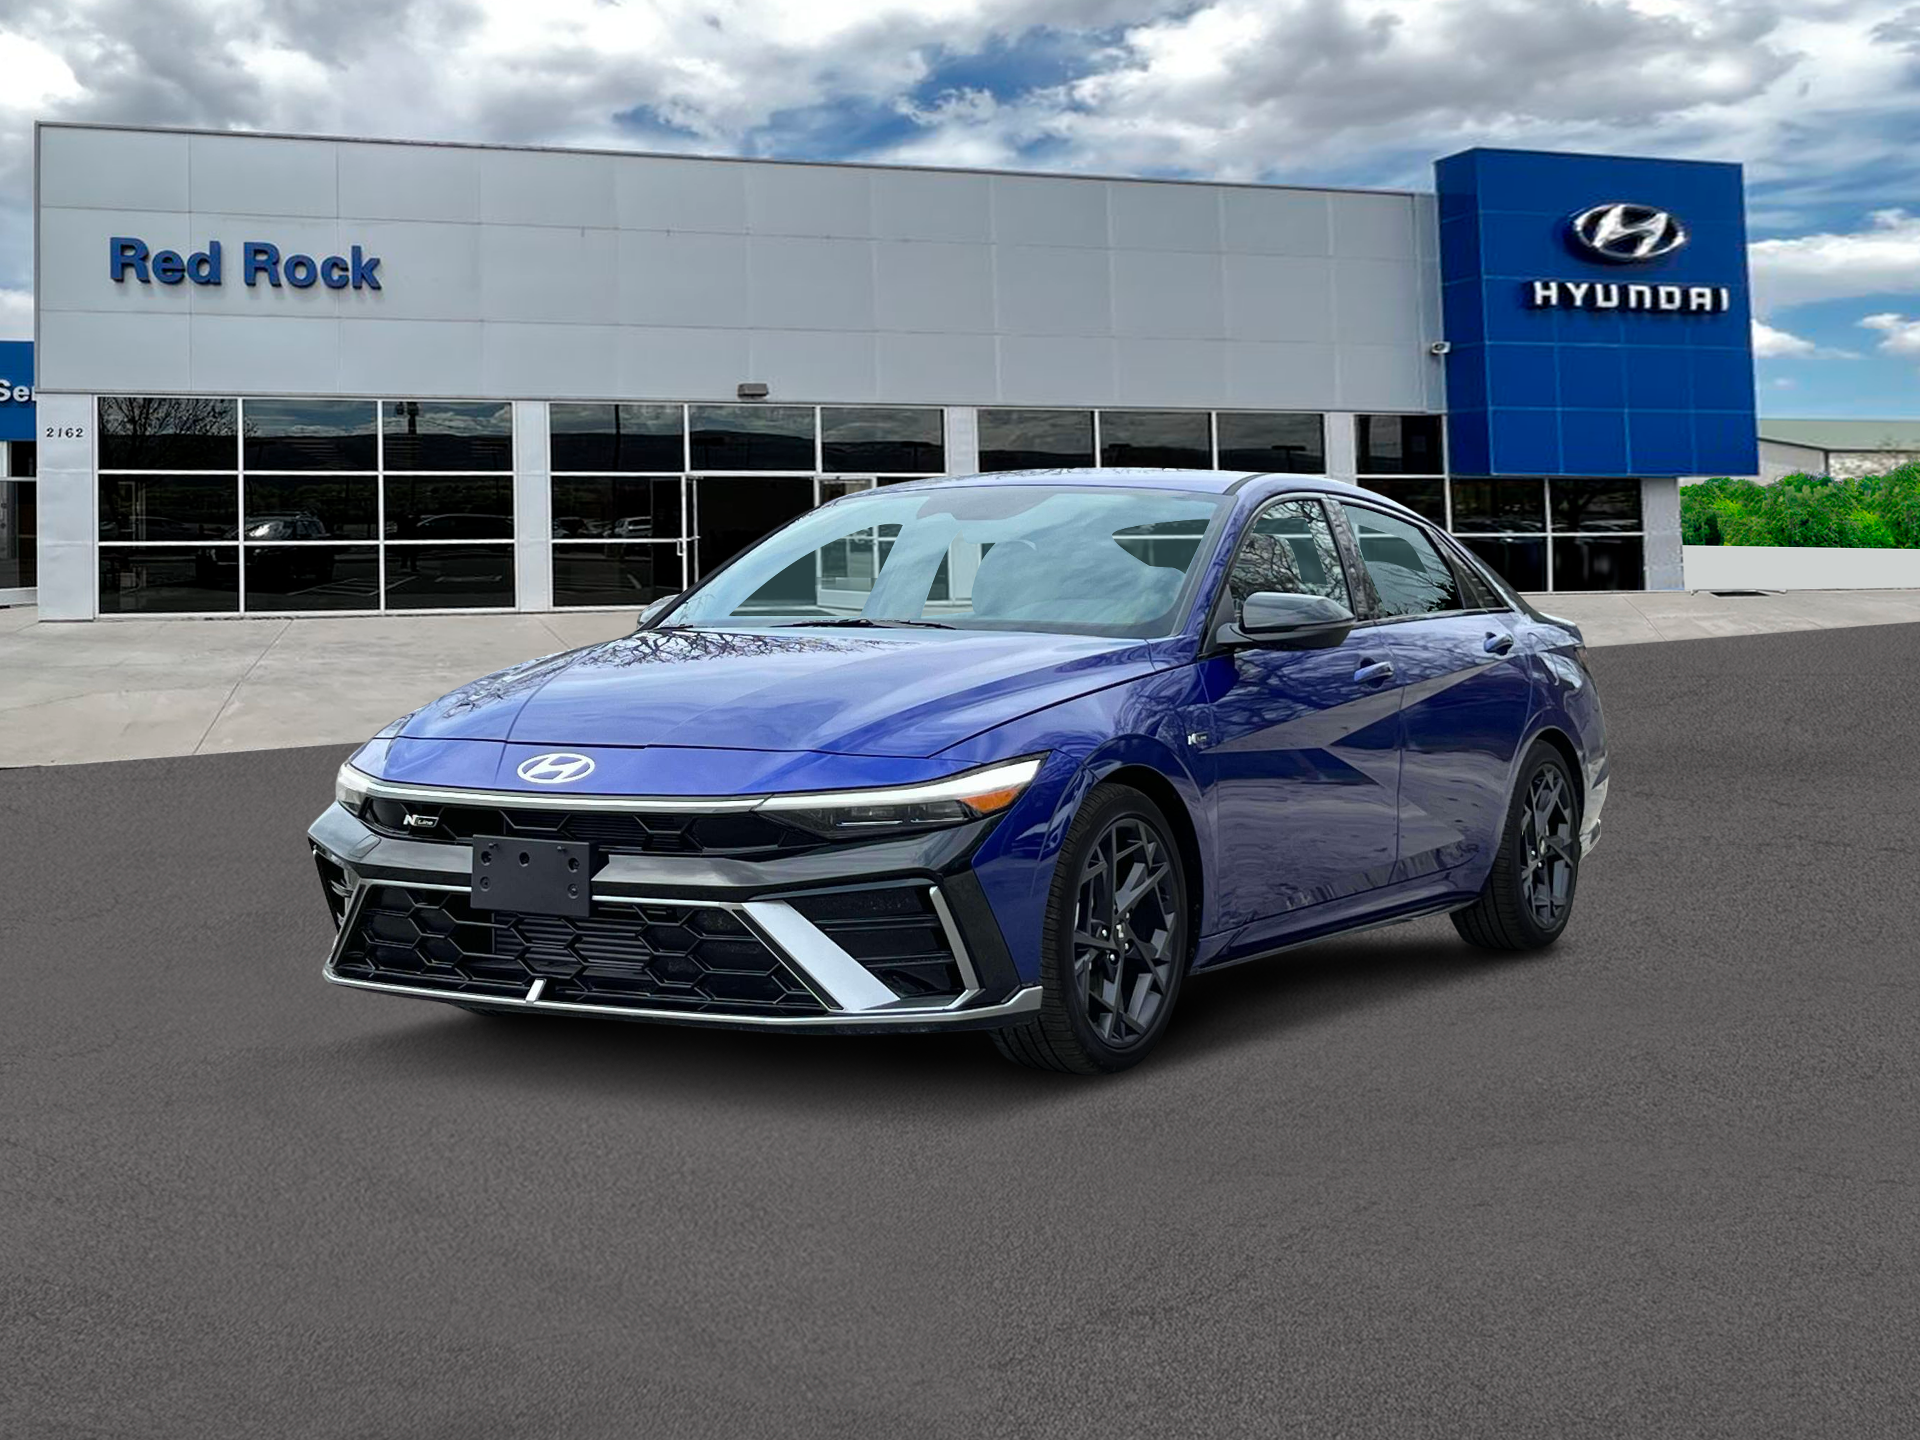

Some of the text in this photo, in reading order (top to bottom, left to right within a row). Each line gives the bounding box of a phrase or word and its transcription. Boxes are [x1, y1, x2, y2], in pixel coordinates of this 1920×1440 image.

[110, 236, 382, 290] Red Rock
[1534, 281, 1730, 312] HYUNDAI
[46, 427, 84, 438] 2162
